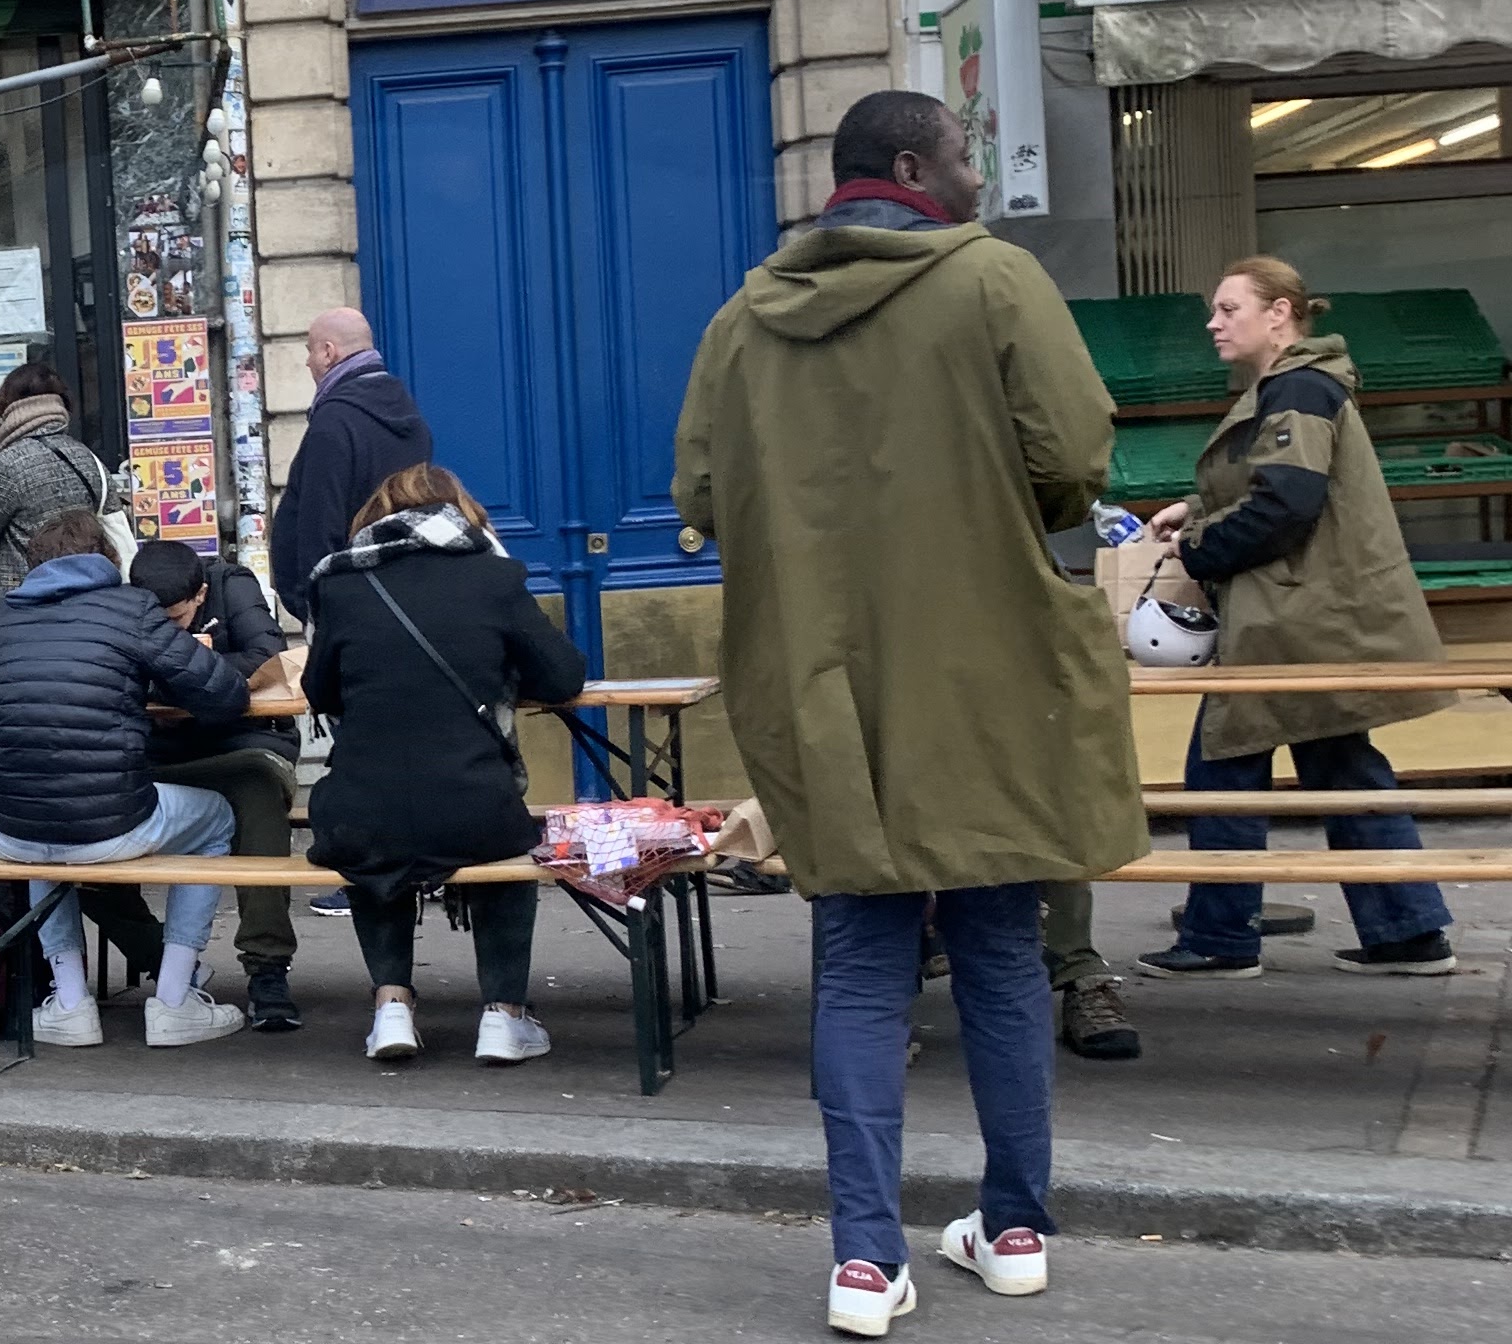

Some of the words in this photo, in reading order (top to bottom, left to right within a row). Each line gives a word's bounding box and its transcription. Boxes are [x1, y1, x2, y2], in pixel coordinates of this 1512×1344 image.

[156, 339, 177, 364] 5
[154, 369, 180, 379] ANS
[163, 461, 184, 486] 5
[161, 490, 187, 499] ANS
[1007, 1237, 1034, 1247] VEJA
[845, 1268, 874, 1282] VEJA
